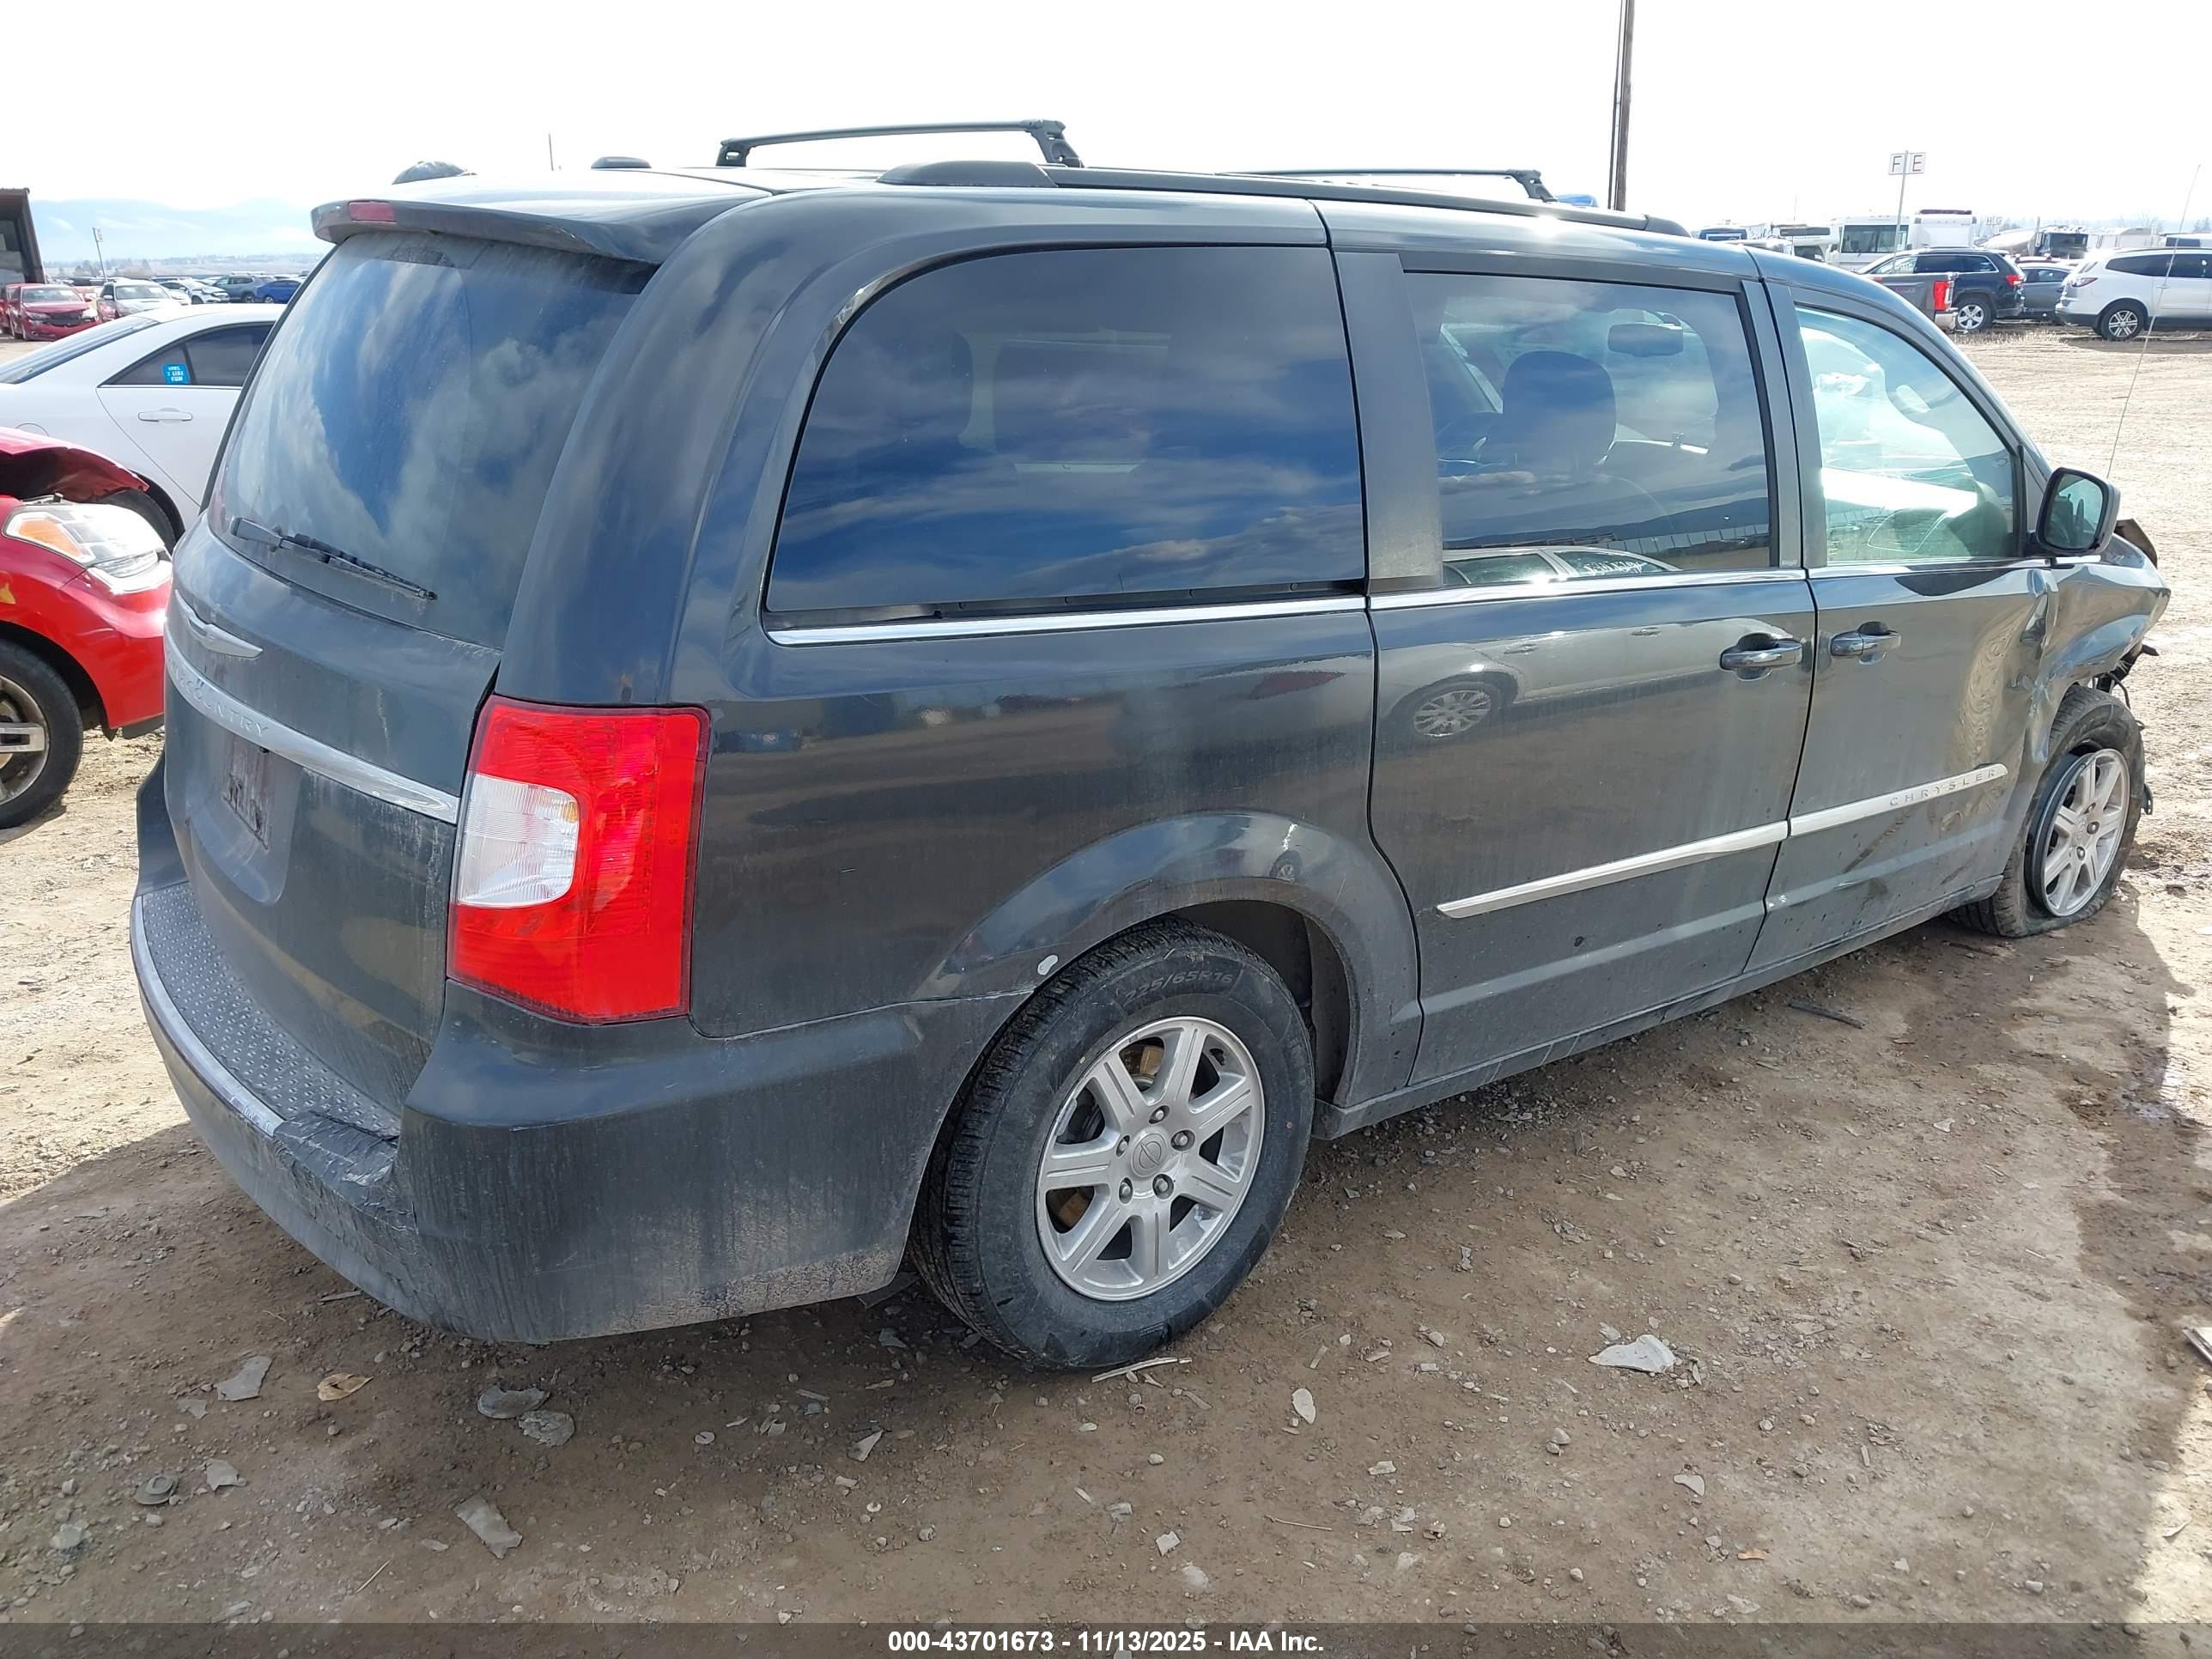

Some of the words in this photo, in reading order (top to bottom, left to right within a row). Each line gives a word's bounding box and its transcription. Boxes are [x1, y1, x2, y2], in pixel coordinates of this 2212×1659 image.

[1892, 155, 1902, 173] F
[1912, 155, 1923, 172] E
[1890, 769, 1995, 805] CHRYSLER
[1122, 970, 1233, 1006] 225/65R16
